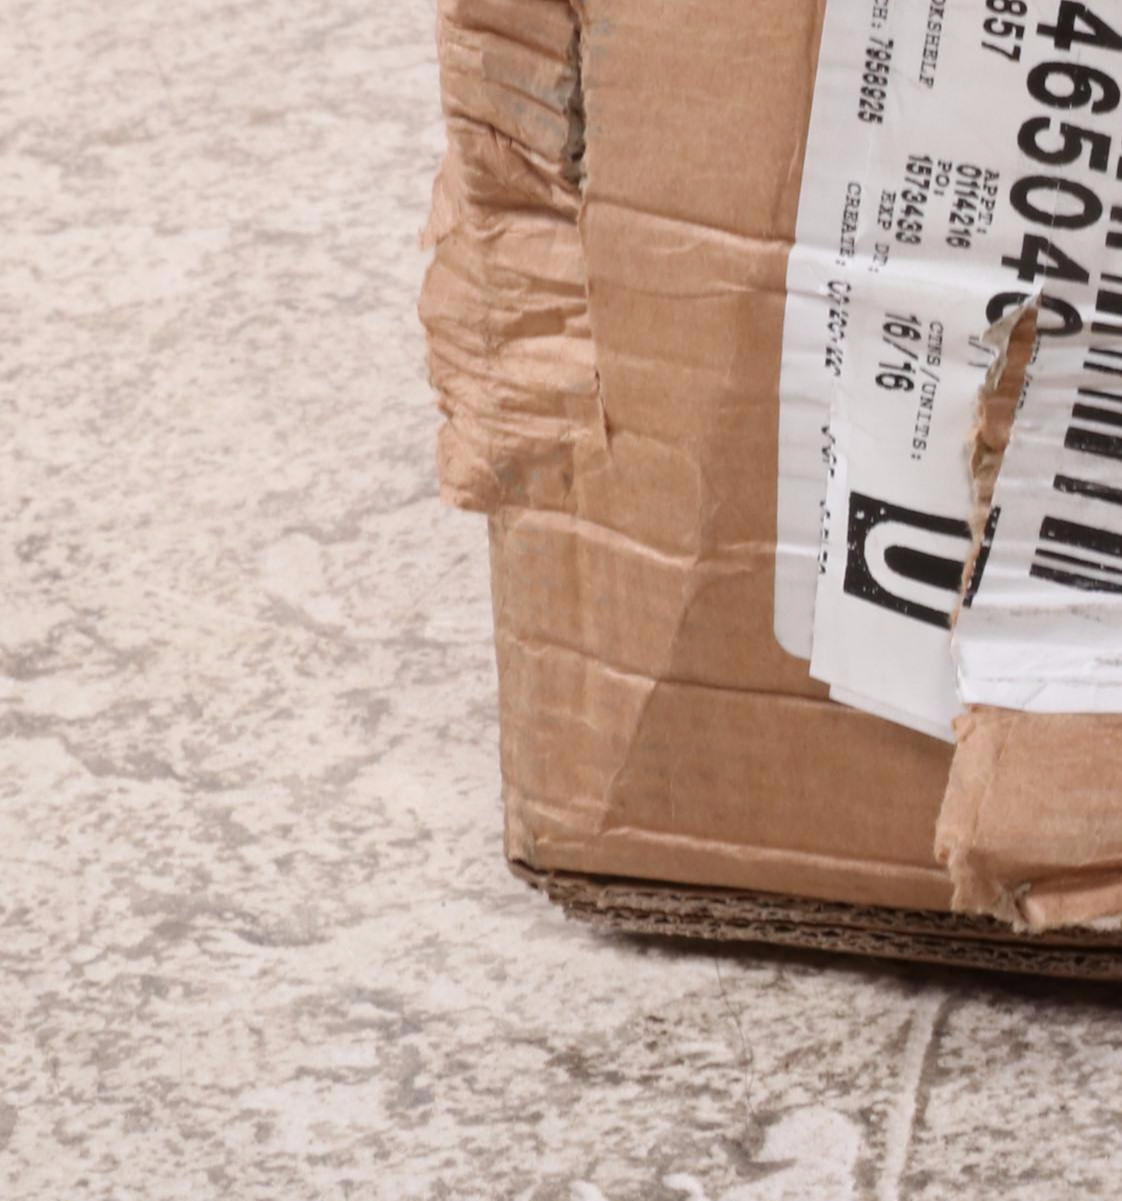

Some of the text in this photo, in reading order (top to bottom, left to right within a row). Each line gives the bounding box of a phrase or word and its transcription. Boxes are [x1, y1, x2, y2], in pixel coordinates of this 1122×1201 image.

[857, 37, 895, 124] 7958925
[876, 189, 897, 231] EXP
[895, 154, 934, 245] 1573433
[933, 160, 953, 196] PO:
[945, 163, 984, 249] 0114216
[976, 168, 1001, 235] APPT:
[875, 312, 923, 393] 16/16
[910, 320, 944, 462] CTNS/UNITS:
